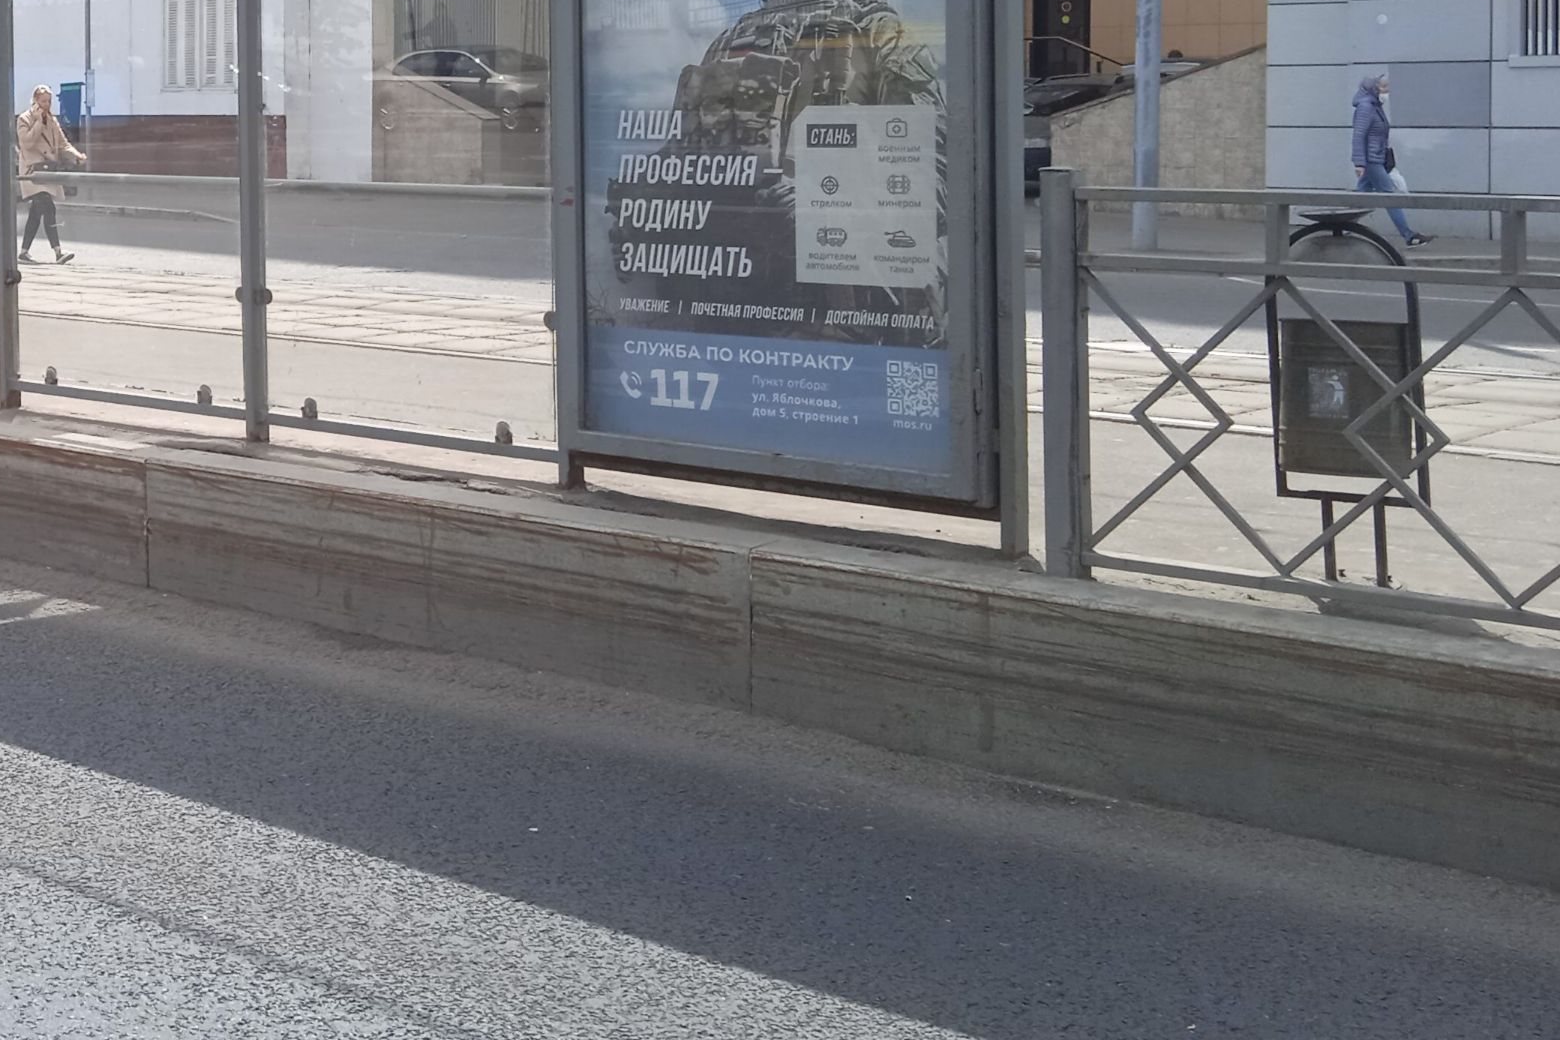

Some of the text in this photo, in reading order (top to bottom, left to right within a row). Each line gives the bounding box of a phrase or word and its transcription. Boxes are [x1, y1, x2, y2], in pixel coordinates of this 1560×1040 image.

[617, 110, 683, 140] НАША
[810, 128, 855, 145] СТАНЬ:
[618, 154, 758, 186] ПРОФЕССИЯ
[810, 200, 852, 208] стрелком
[878, 200, 921, 209] минером
[618, 198, 712, 233] РОДИНУ
[619, 242, 753, 279] ЗАЩИЩАТЬ
[808, 252, 857, 261] водителем
[873, 255, 930, 264] командиром
[806, 262, 860, 271] автомобиля
[619, 298, 934, 330] УВАЖЕНИЕ ПОЧЕТНАЯ ПРОФЕССИЯ ДОСТОЙНАЯ ОПЛАТА
[624, 340, 854, 371] СЛУЖБА ПО КОНТРАКТУ
[650, 368, 719, 411] 117
[752, 375, 830, 392] Пункт отбора:
[752, 393, 841, 409] ул. Яблочкова,
[752, 408, 776, 418] дом
[792, 413, 849, 425] строение
[893, 419, 933, 431] mos.ru
